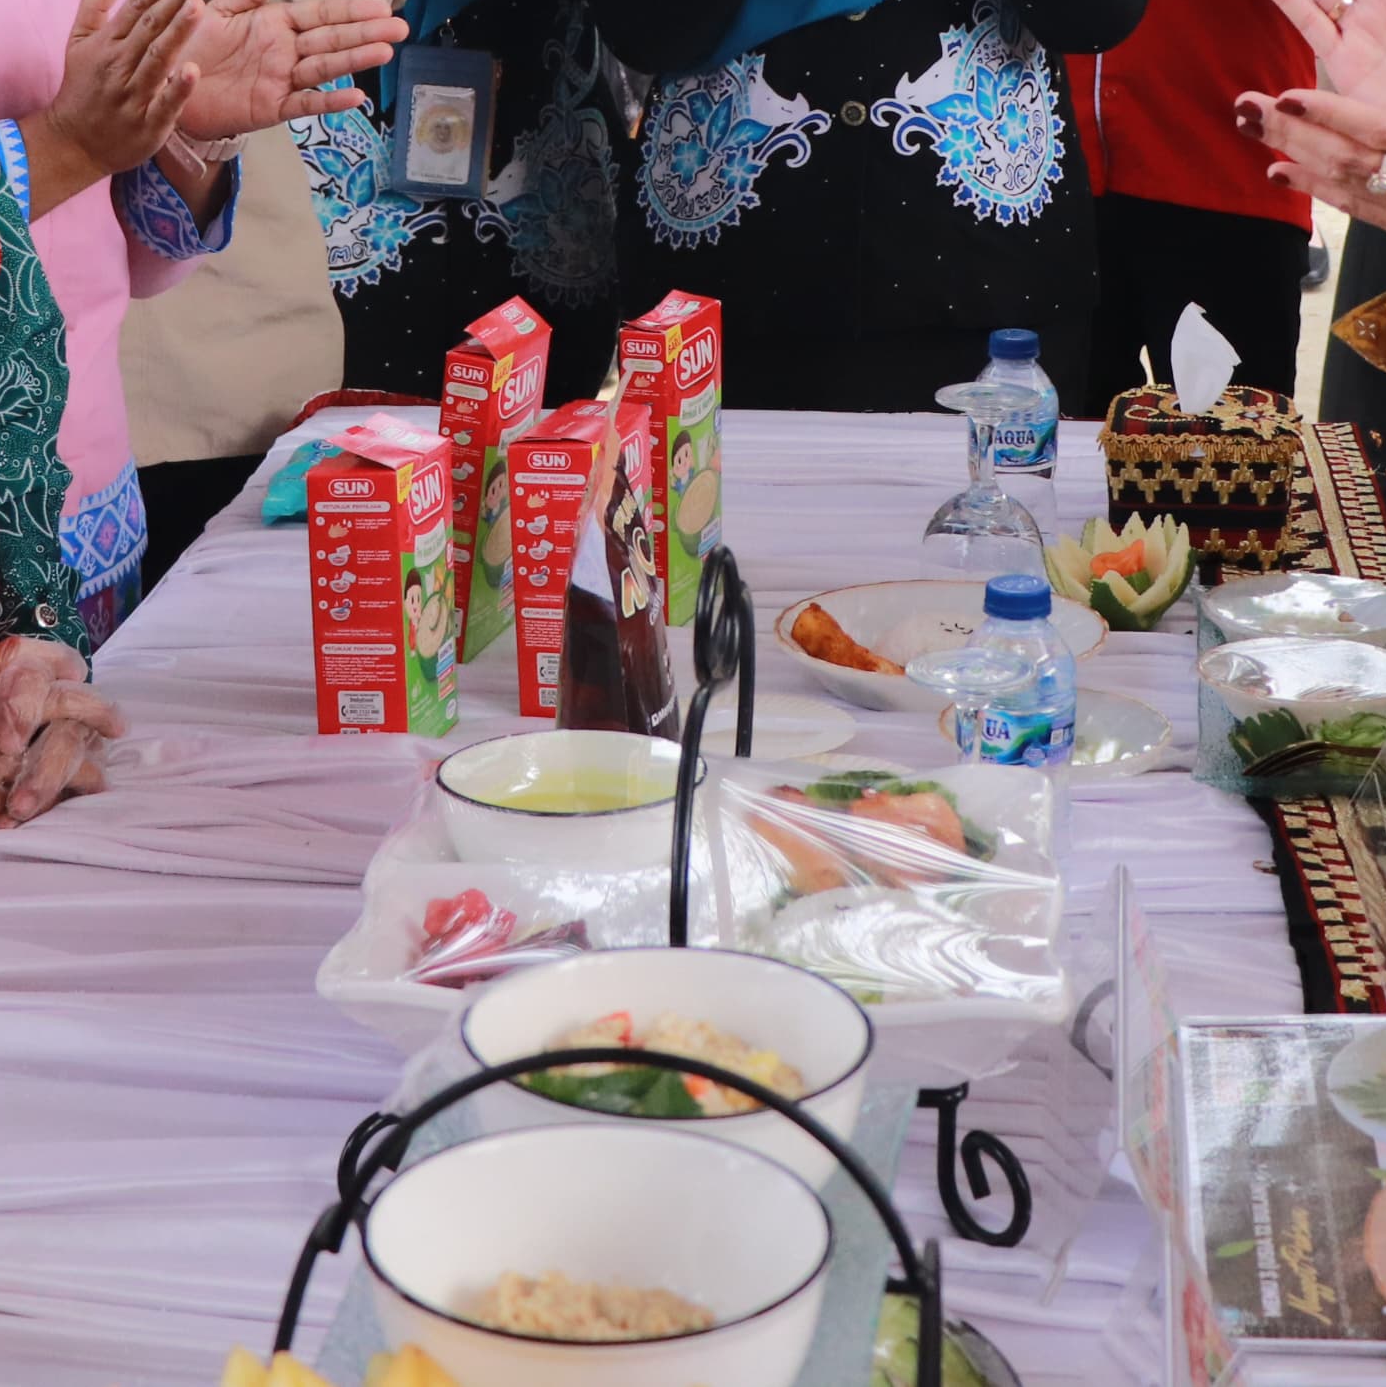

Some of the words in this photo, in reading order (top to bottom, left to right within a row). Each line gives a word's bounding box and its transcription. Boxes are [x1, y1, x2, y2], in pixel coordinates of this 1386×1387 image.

[627, 341, 657, 354] SUN
[680, 334, 713, 381] SUN
[452, 365, 485, 382] SUN
[503, 363, 538, 411] SUN
[995, 430, 1035, 448] AQUA
[532, 453, 566, 467] SUN
[333, 481, 370, 495] SUN
[411, 469, 441, 516] SUN
